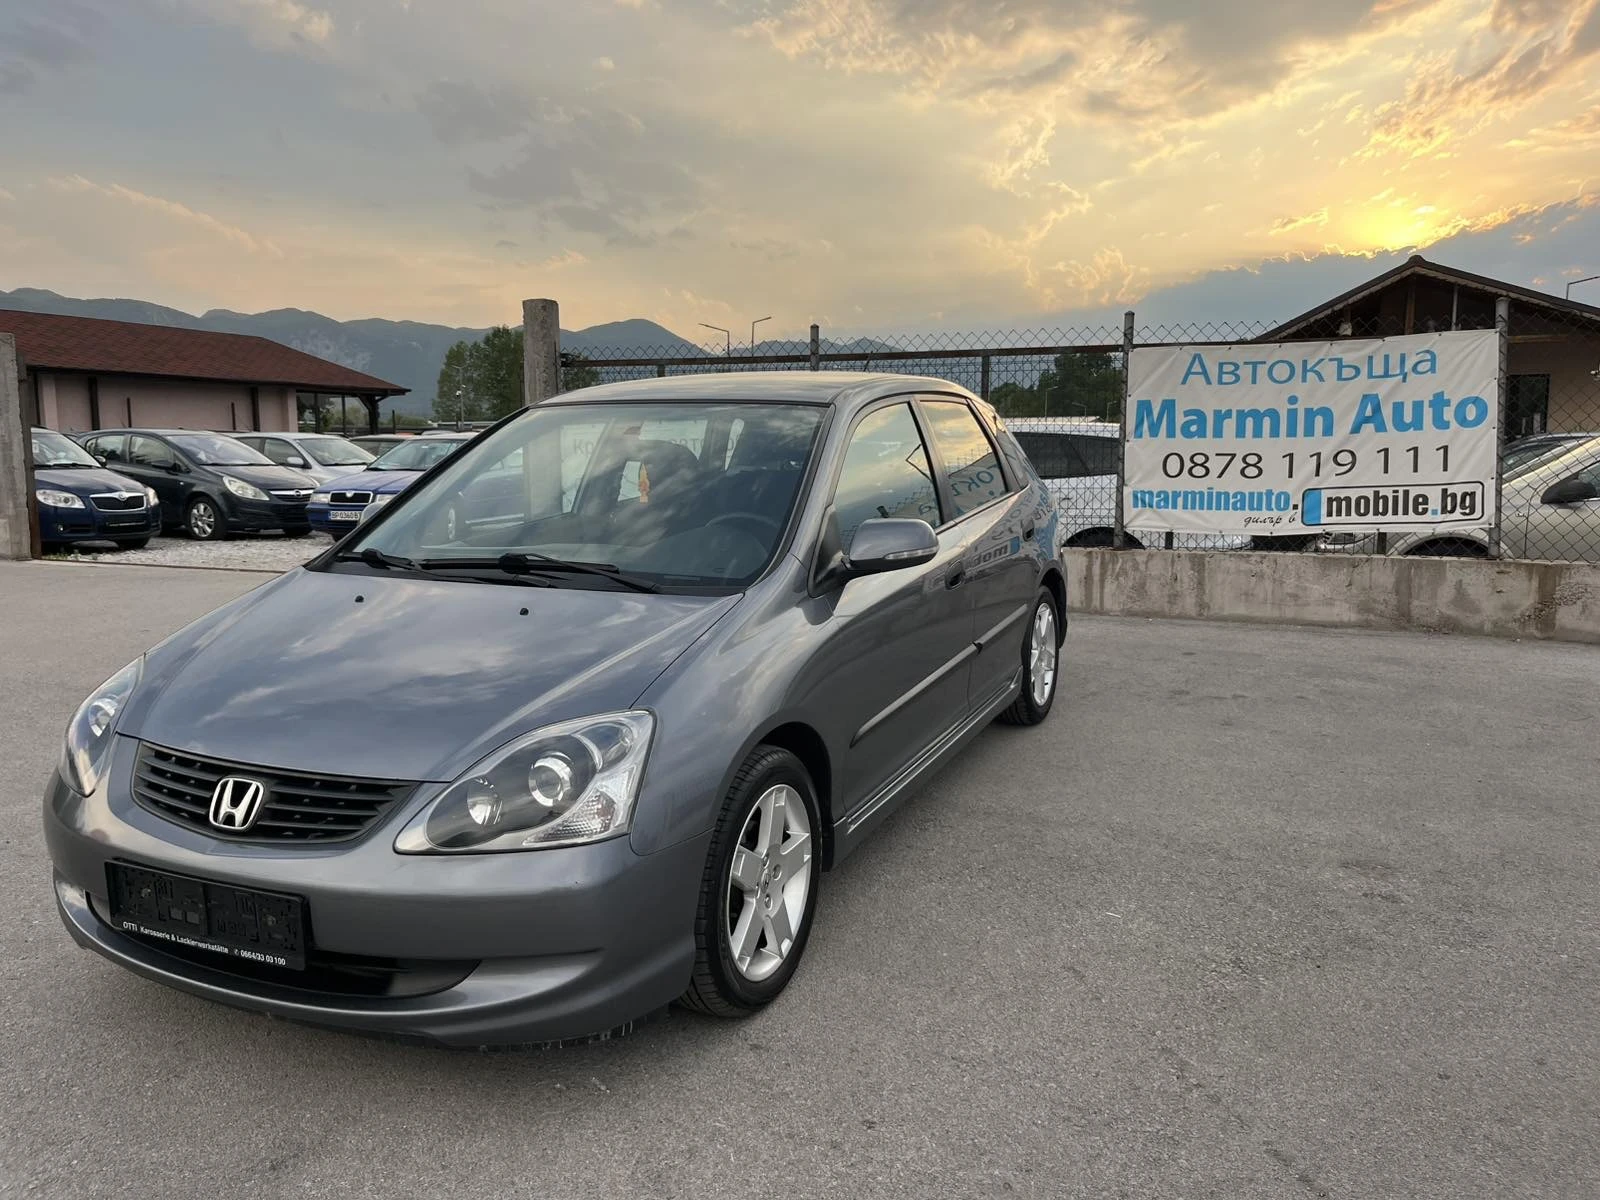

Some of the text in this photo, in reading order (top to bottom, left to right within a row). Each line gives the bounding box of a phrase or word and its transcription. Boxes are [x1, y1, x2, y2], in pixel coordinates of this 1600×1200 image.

[1180, 348, 1438, 386] Автокъща
[1133, 391, 1489, 440] Marmin Auto
[1162, 444, 1450, 480] 0878 119 111
[1326, 488, 1477, 518] mobile.bg
[140, 926, 170, 940] Karosserie
